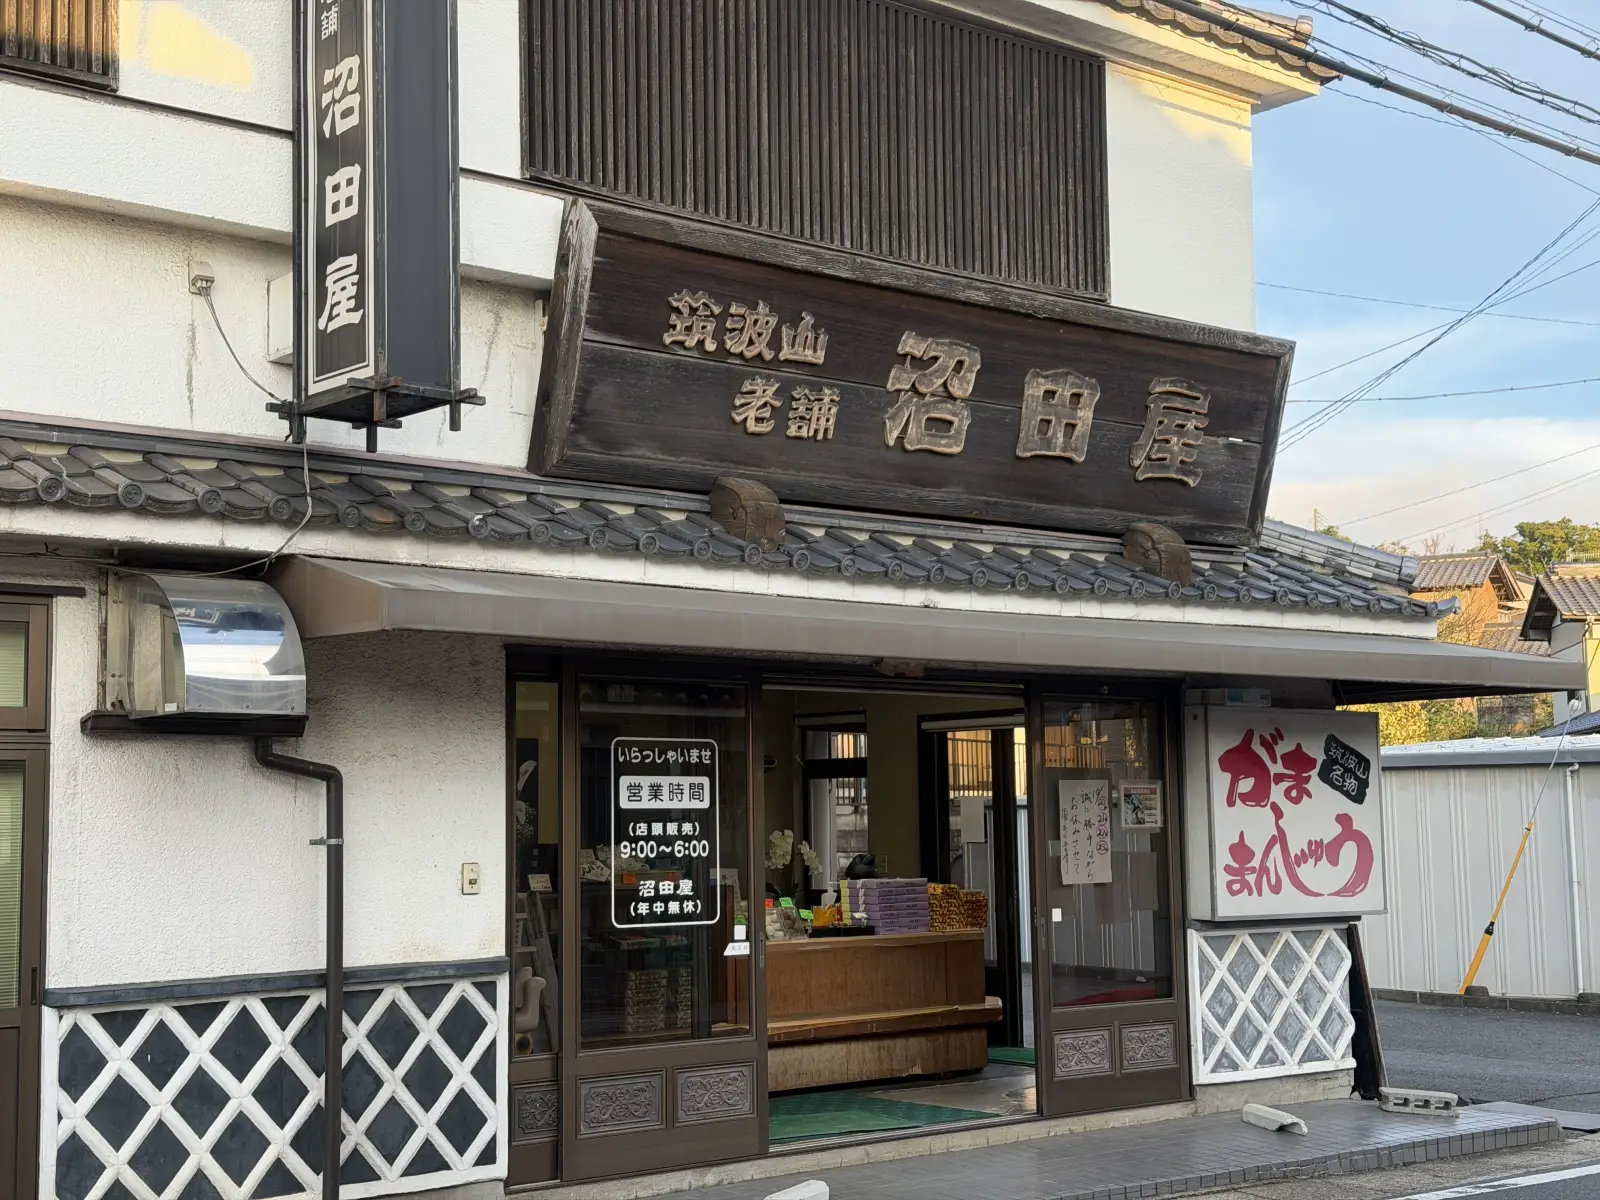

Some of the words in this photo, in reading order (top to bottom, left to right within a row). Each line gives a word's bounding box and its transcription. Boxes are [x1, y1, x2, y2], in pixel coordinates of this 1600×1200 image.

[320, 0, 339, 40] 舗
[317, 54, 364, 334] 沼田屋
[662, 288, 829, 366] 筑波山
[730, 375, 841, 441] 老舗
[883, 330, 1212, 488] 沼田屋
[618, 747, 712, 764] いらっしゃいませ
[1218, 727, 1317, 808] がま
[1328, 741, 1369, 780] 筑波山
[1329, 764, 1359, 796] 名物
[626, 781, 705, 803] 営業時間
[1223, 801, 1374, 898] まんじゅう
[638, 879, 694, 897] 沼田屋
